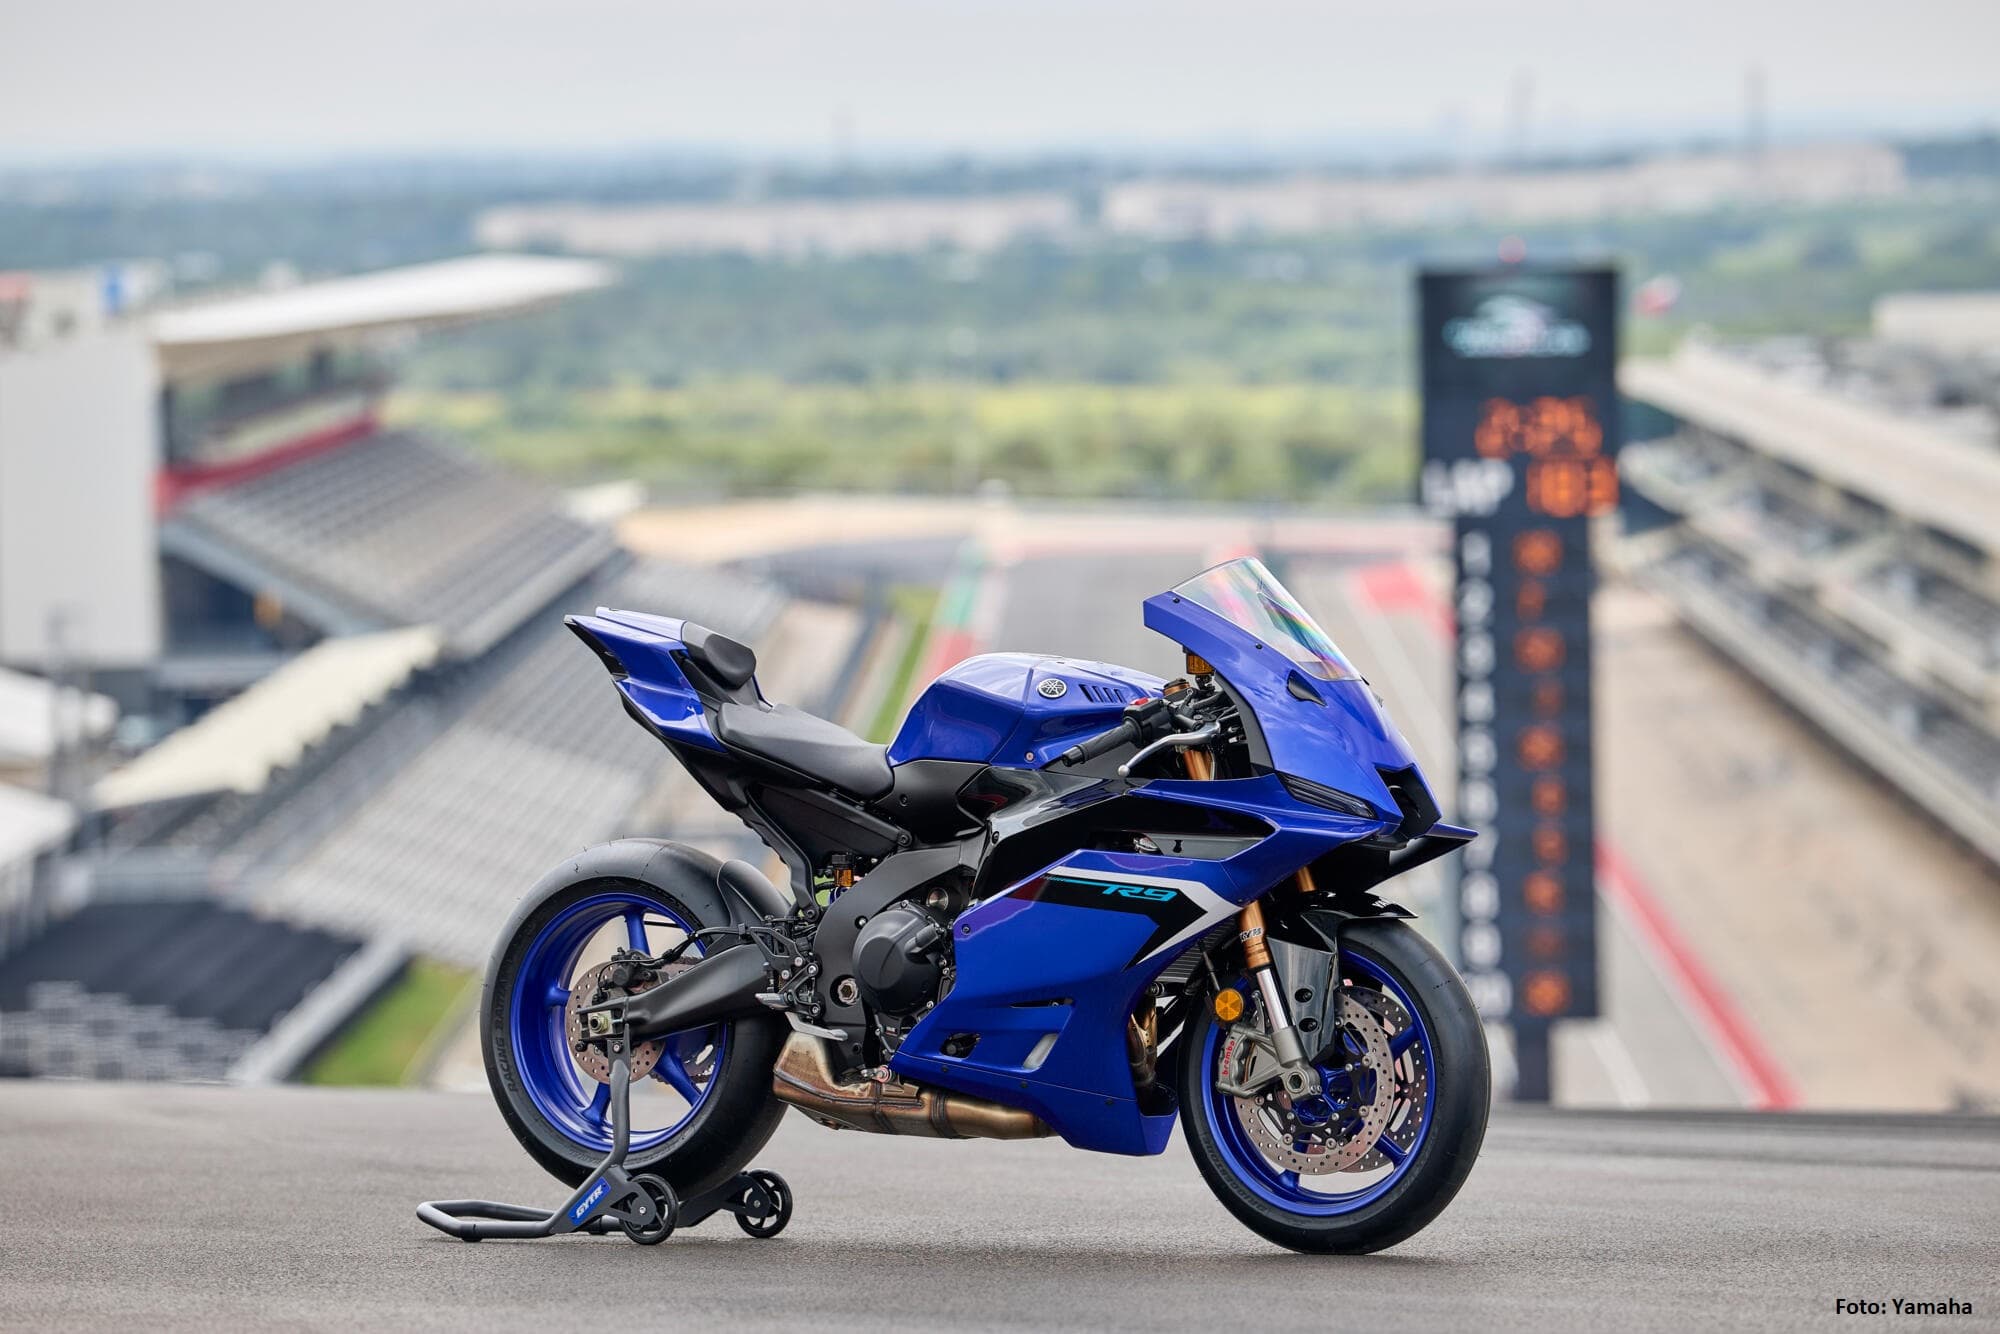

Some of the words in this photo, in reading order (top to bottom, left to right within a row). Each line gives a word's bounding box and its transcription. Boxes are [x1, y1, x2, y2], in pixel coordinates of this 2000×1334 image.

[1095, 882, 1177, 901] R9
[495, 1036, 518, 1092] RACING
[1222, 1040, 1235, 1075] brembo
[575, 1184, 603, 1218] GYTR
